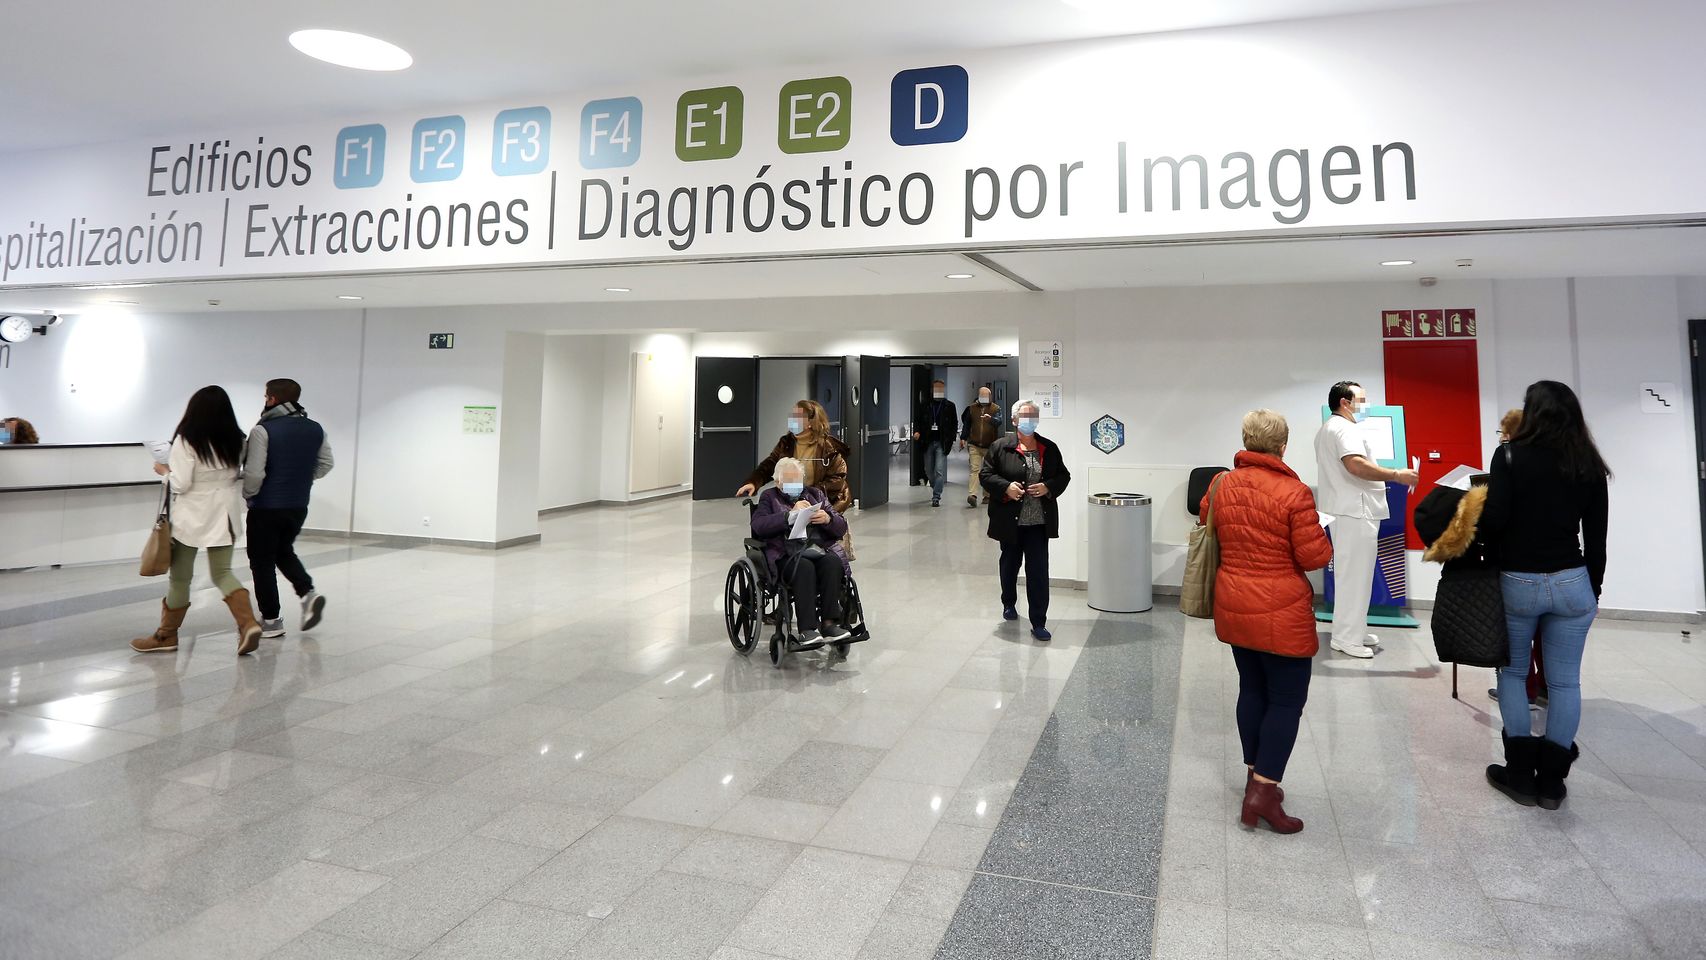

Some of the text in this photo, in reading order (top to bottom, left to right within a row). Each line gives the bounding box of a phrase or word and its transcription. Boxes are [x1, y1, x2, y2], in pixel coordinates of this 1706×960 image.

[147, 82, 945, 196] Edificios F1 F2 F3 F4 E1 E2 D
[0, 139, 1417, 282] pitalización Extracciones Diagnóstico por Imagen
